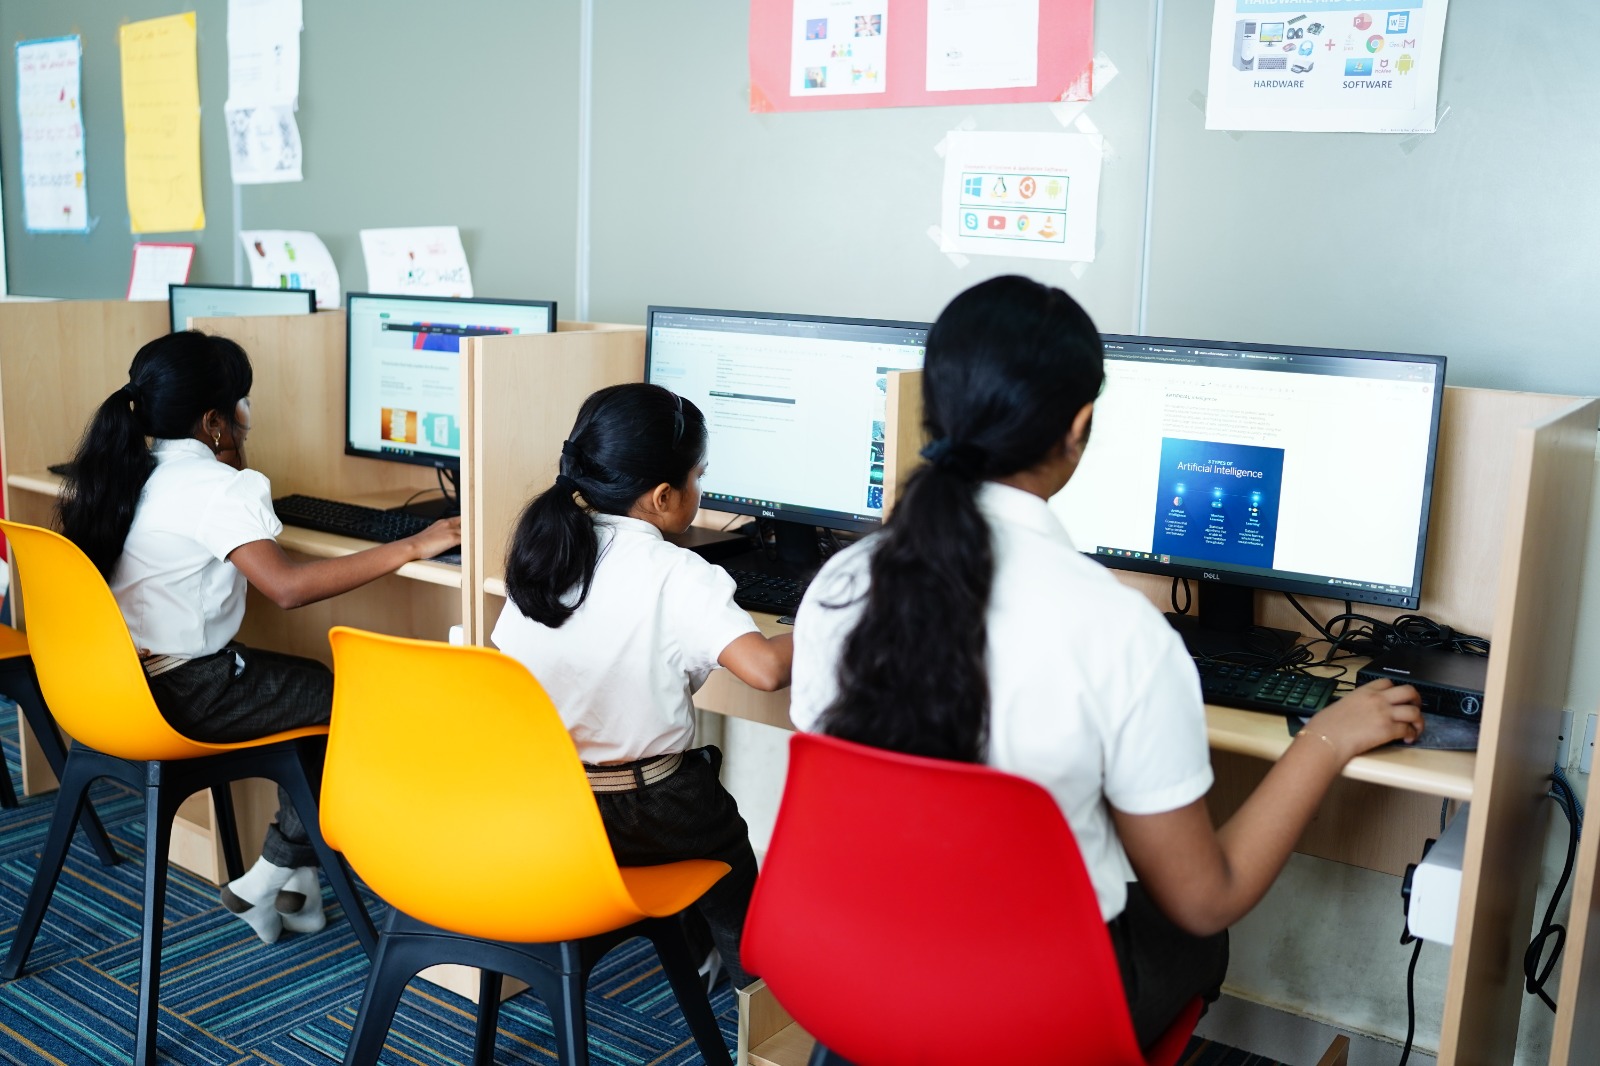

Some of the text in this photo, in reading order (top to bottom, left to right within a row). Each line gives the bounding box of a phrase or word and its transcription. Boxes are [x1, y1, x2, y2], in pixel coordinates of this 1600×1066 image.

[1253, 80, 1304, 89] HARDWARE
[1342, 80, 1393, 89] SOFTWARE
[1177, 461, 1263, 479] Artificial Intelligence
[1203, 572, 1220, 580] DELL
